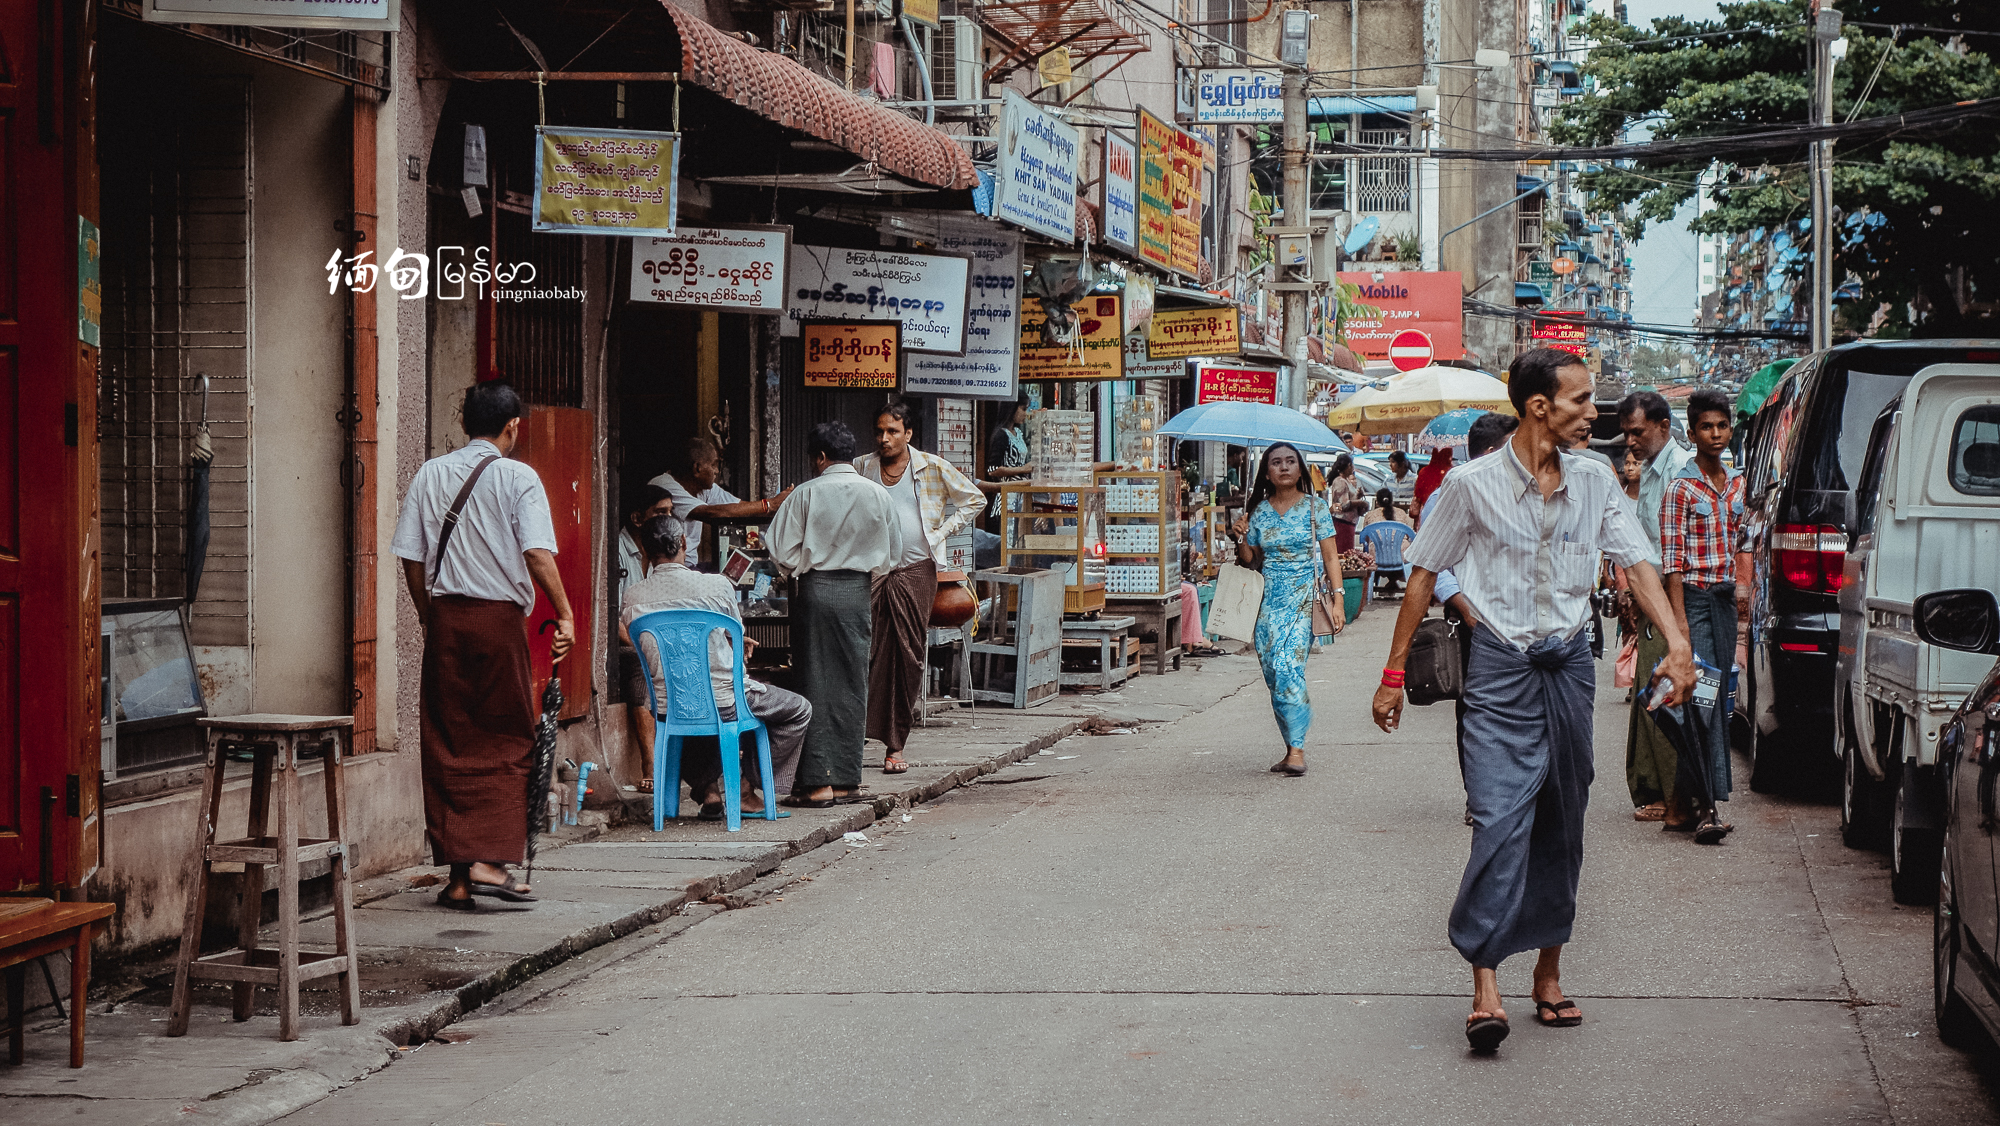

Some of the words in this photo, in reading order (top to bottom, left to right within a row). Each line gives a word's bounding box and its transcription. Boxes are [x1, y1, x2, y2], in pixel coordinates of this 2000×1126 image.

[1014, 167, 1031, 185] KHIT
[1032, 175, 1047, 194] SAN
[1050, 183, 1074, 207] YADANA
[1358, 284, 1409, 299] Mobile
[1216, 372, 1225, 382] G
[1253, 374, 1260, 383] S
